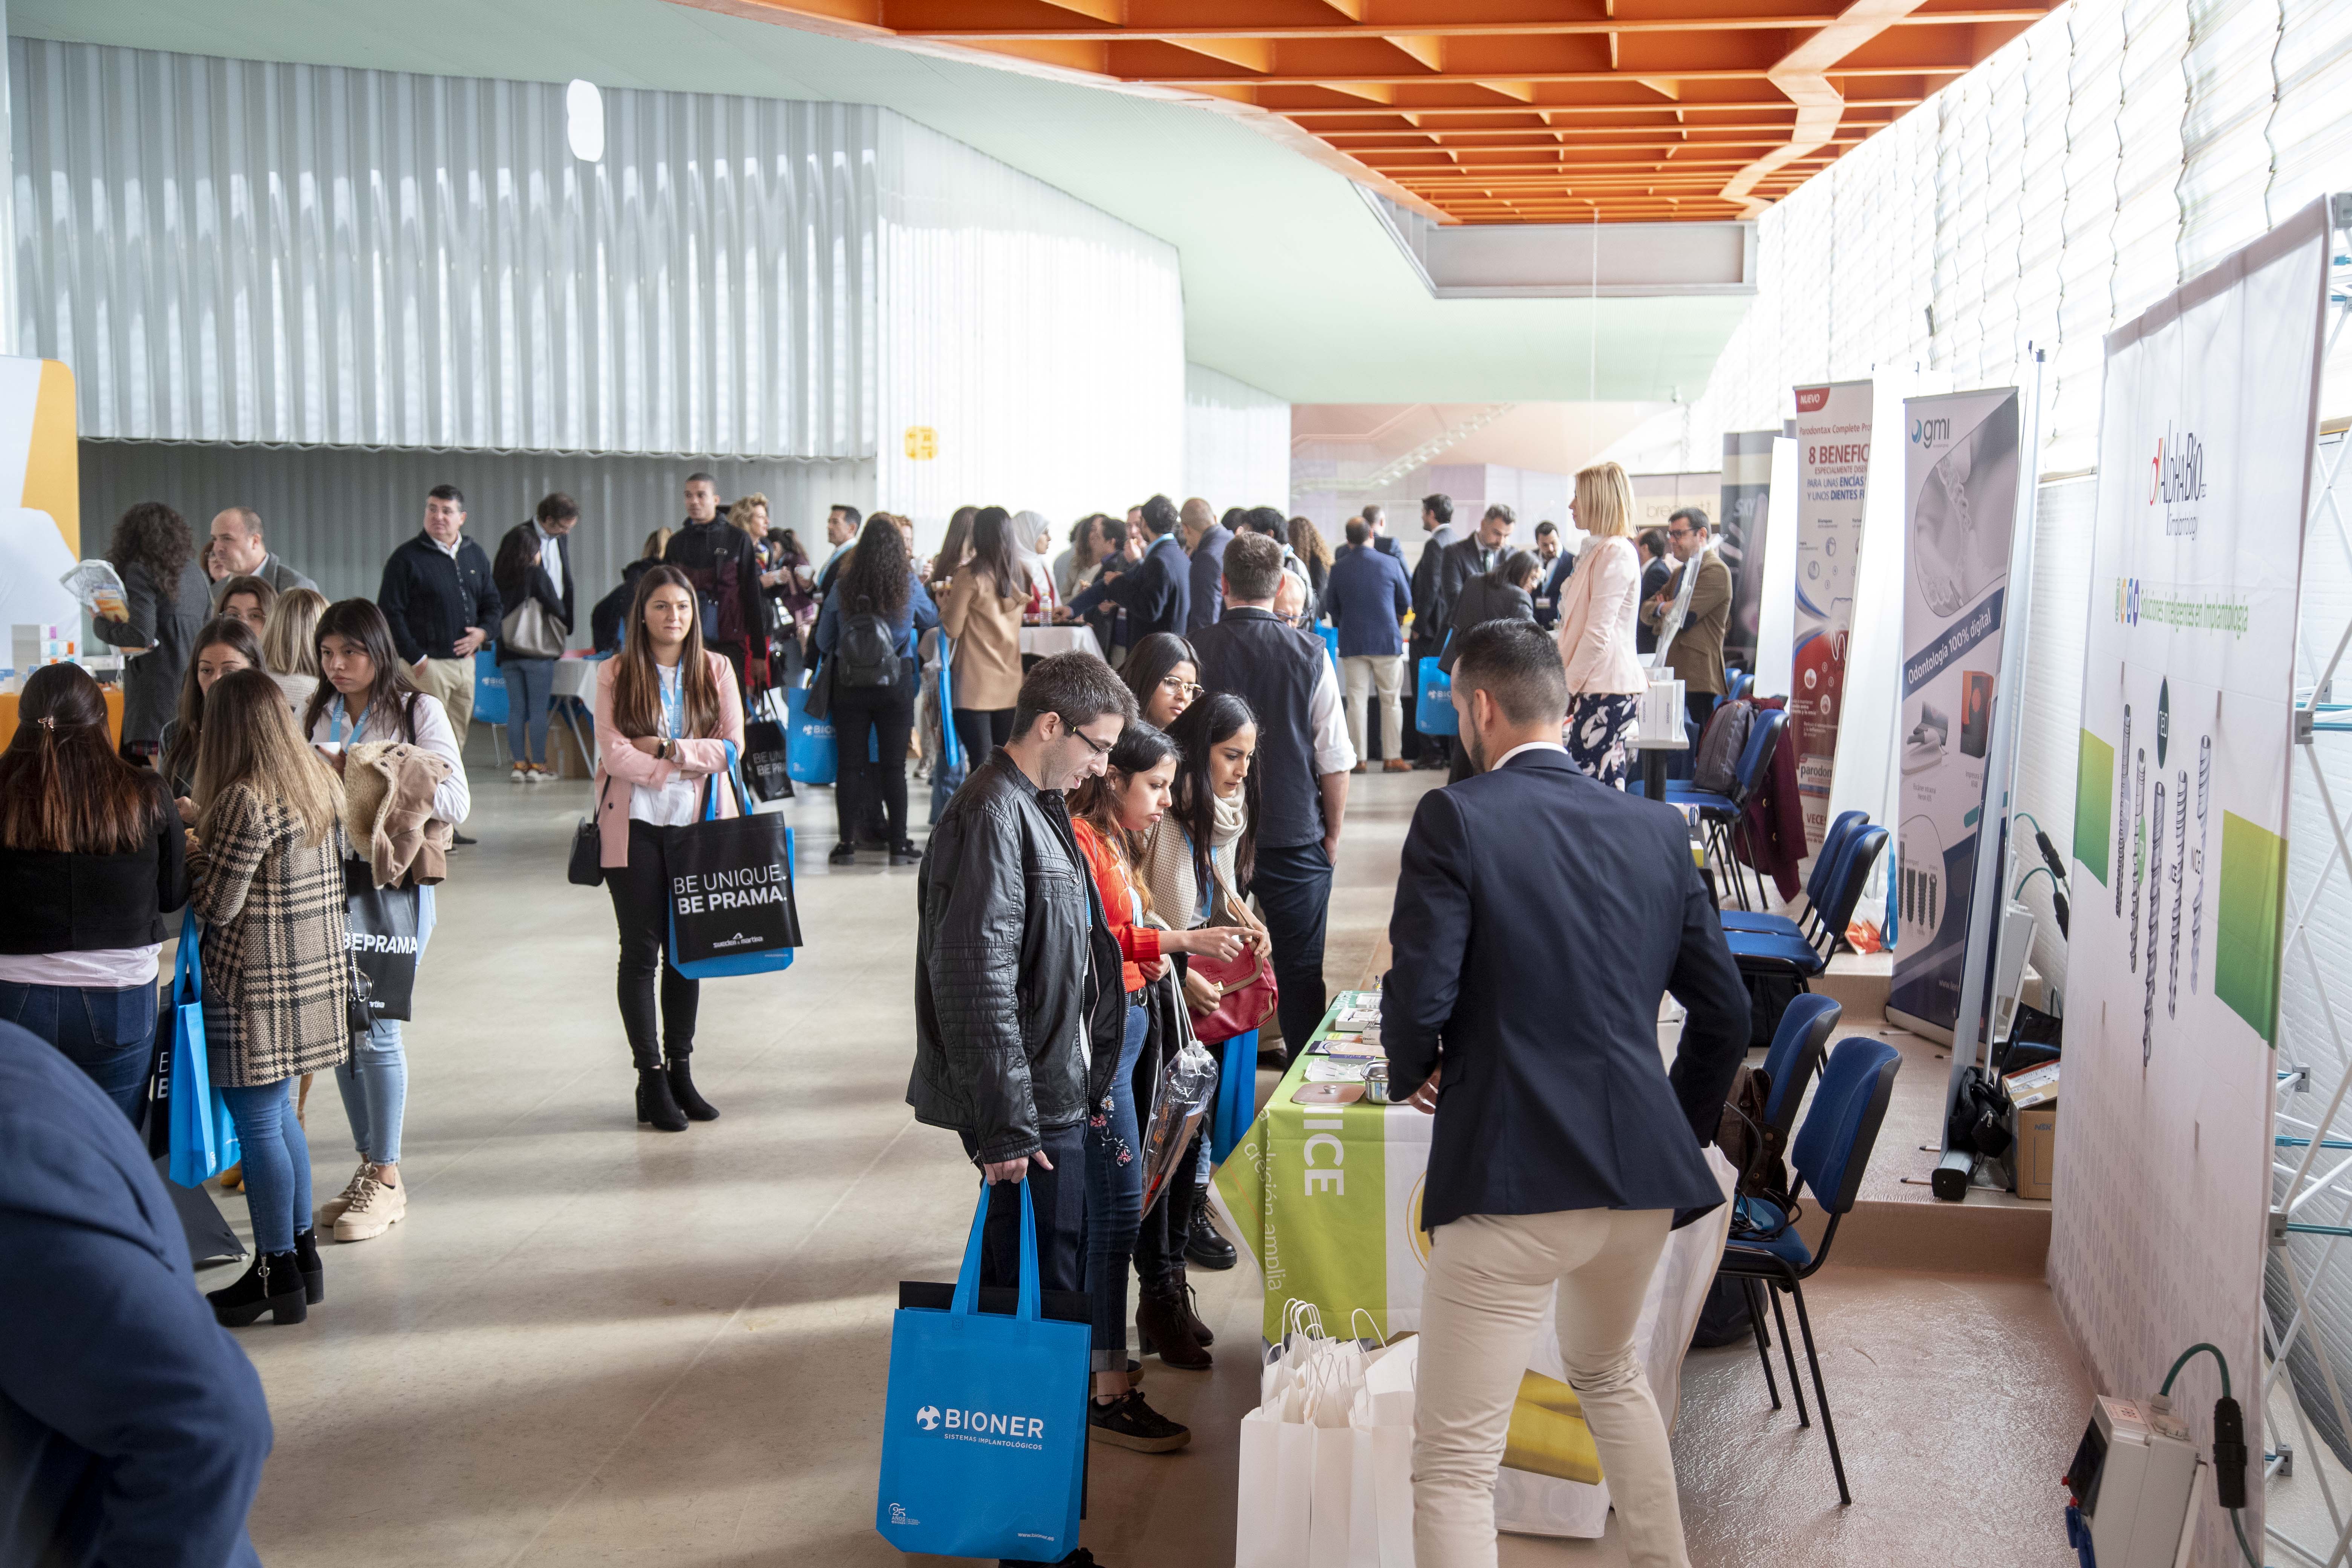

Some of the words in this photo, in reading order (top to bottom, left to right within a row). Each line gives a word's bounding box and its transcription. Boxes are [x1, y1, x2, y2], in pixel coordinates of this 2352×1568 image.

[1800, 394, 1821, 404] NUEVO
[1800, 426, 1831, 435] Parodontax
[1832, 423, 1860, 435] Complete
[1861, 423, 1872, 431] Pro
[1809, 446, 1816, 465] 8
[1819, 443, 1870, 464] BENEFIC
[1815, 465, 1853, 475] ESPECIALMENTE
[1807, 478, 1822, 487] PARA
[1824, 478, 1838, 487] UNAS
[1840, 474, 1864, 487] ENCÍAS
[1807, 492, 1810, 500] Y
[1812, 492, 1829, 501] UNOS
[1831, 489, 1857, 500] DIENTES
[2140, 589, 2164, 623] Soluciones
[2164, 592, 2194, 633] inteligentes
[2196, 602, 2203, 628] en
[2203, 593, 2249, 640] Implantología
[1908, 643, 1948, 684] Odontología
[1949, 627, 1969, 653] 100%
[1970, 608, 1991, 637] digital
[2190, 845, 2201, 875] NICE
[674, 875, 699, 895] BE
[704, 864, 787, 891] UNIQUE.
[678, 895, 705, 915] BE
[709, 885, 787, 911] PRAMA.
[363, 934, 418, 954] PRAMA
[713, 940, 736, 948] sweden
[1264, 1224, 1286, 1291] amplia
[945, 1408, 1044, 1439] BIONER
[944, 1433, 977, 1442] SISTEMAS
[978, 1438, 1043, 1450] IMPLANTOLÓGICOS
[893, 1507, 906, 1516] 25
